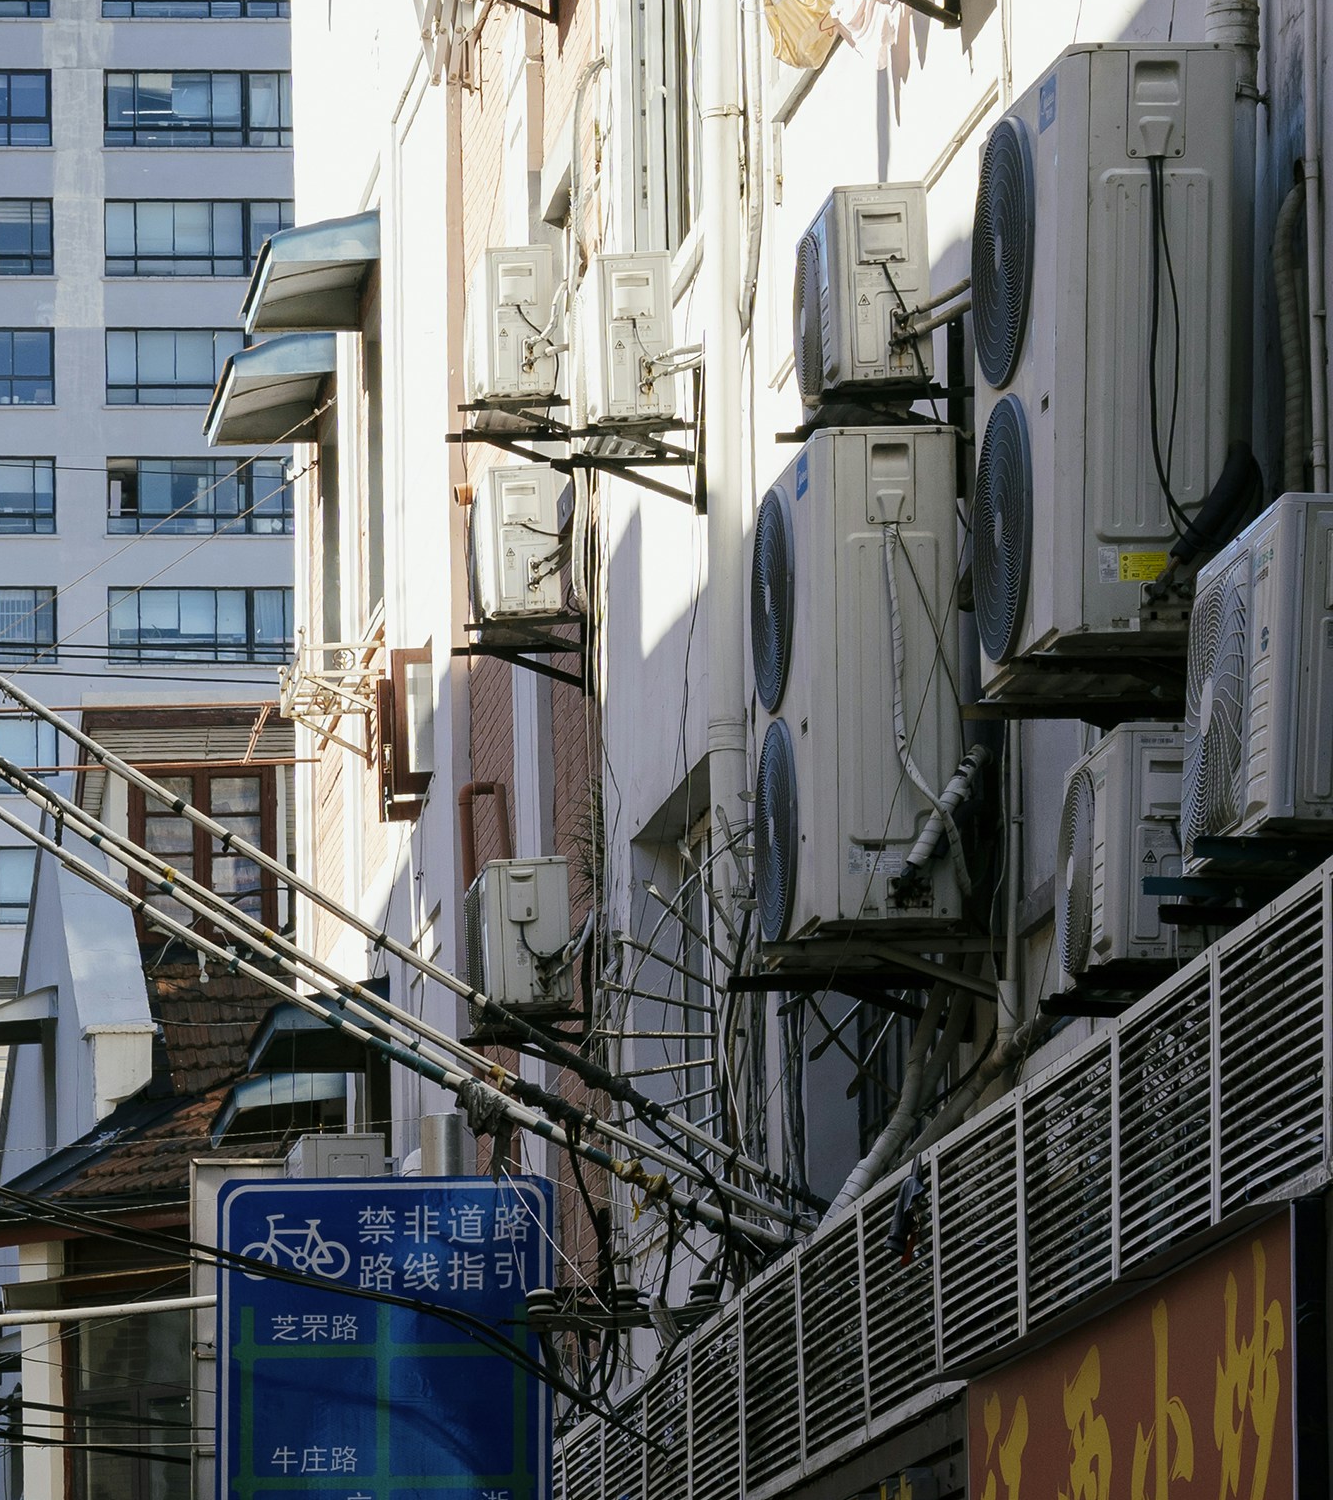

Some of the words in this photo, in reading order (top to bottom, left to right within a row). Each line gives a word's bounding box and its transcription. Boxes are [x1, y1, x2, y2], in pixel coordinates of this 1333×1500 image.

[358, 1204, 531, 1246] 禁非道路
[358, 1251, 527, 1292] 路线指引
[270, 1314, 359, 1341] 芝罘路
[271, 1446, 358, 1474] 牛庄路
